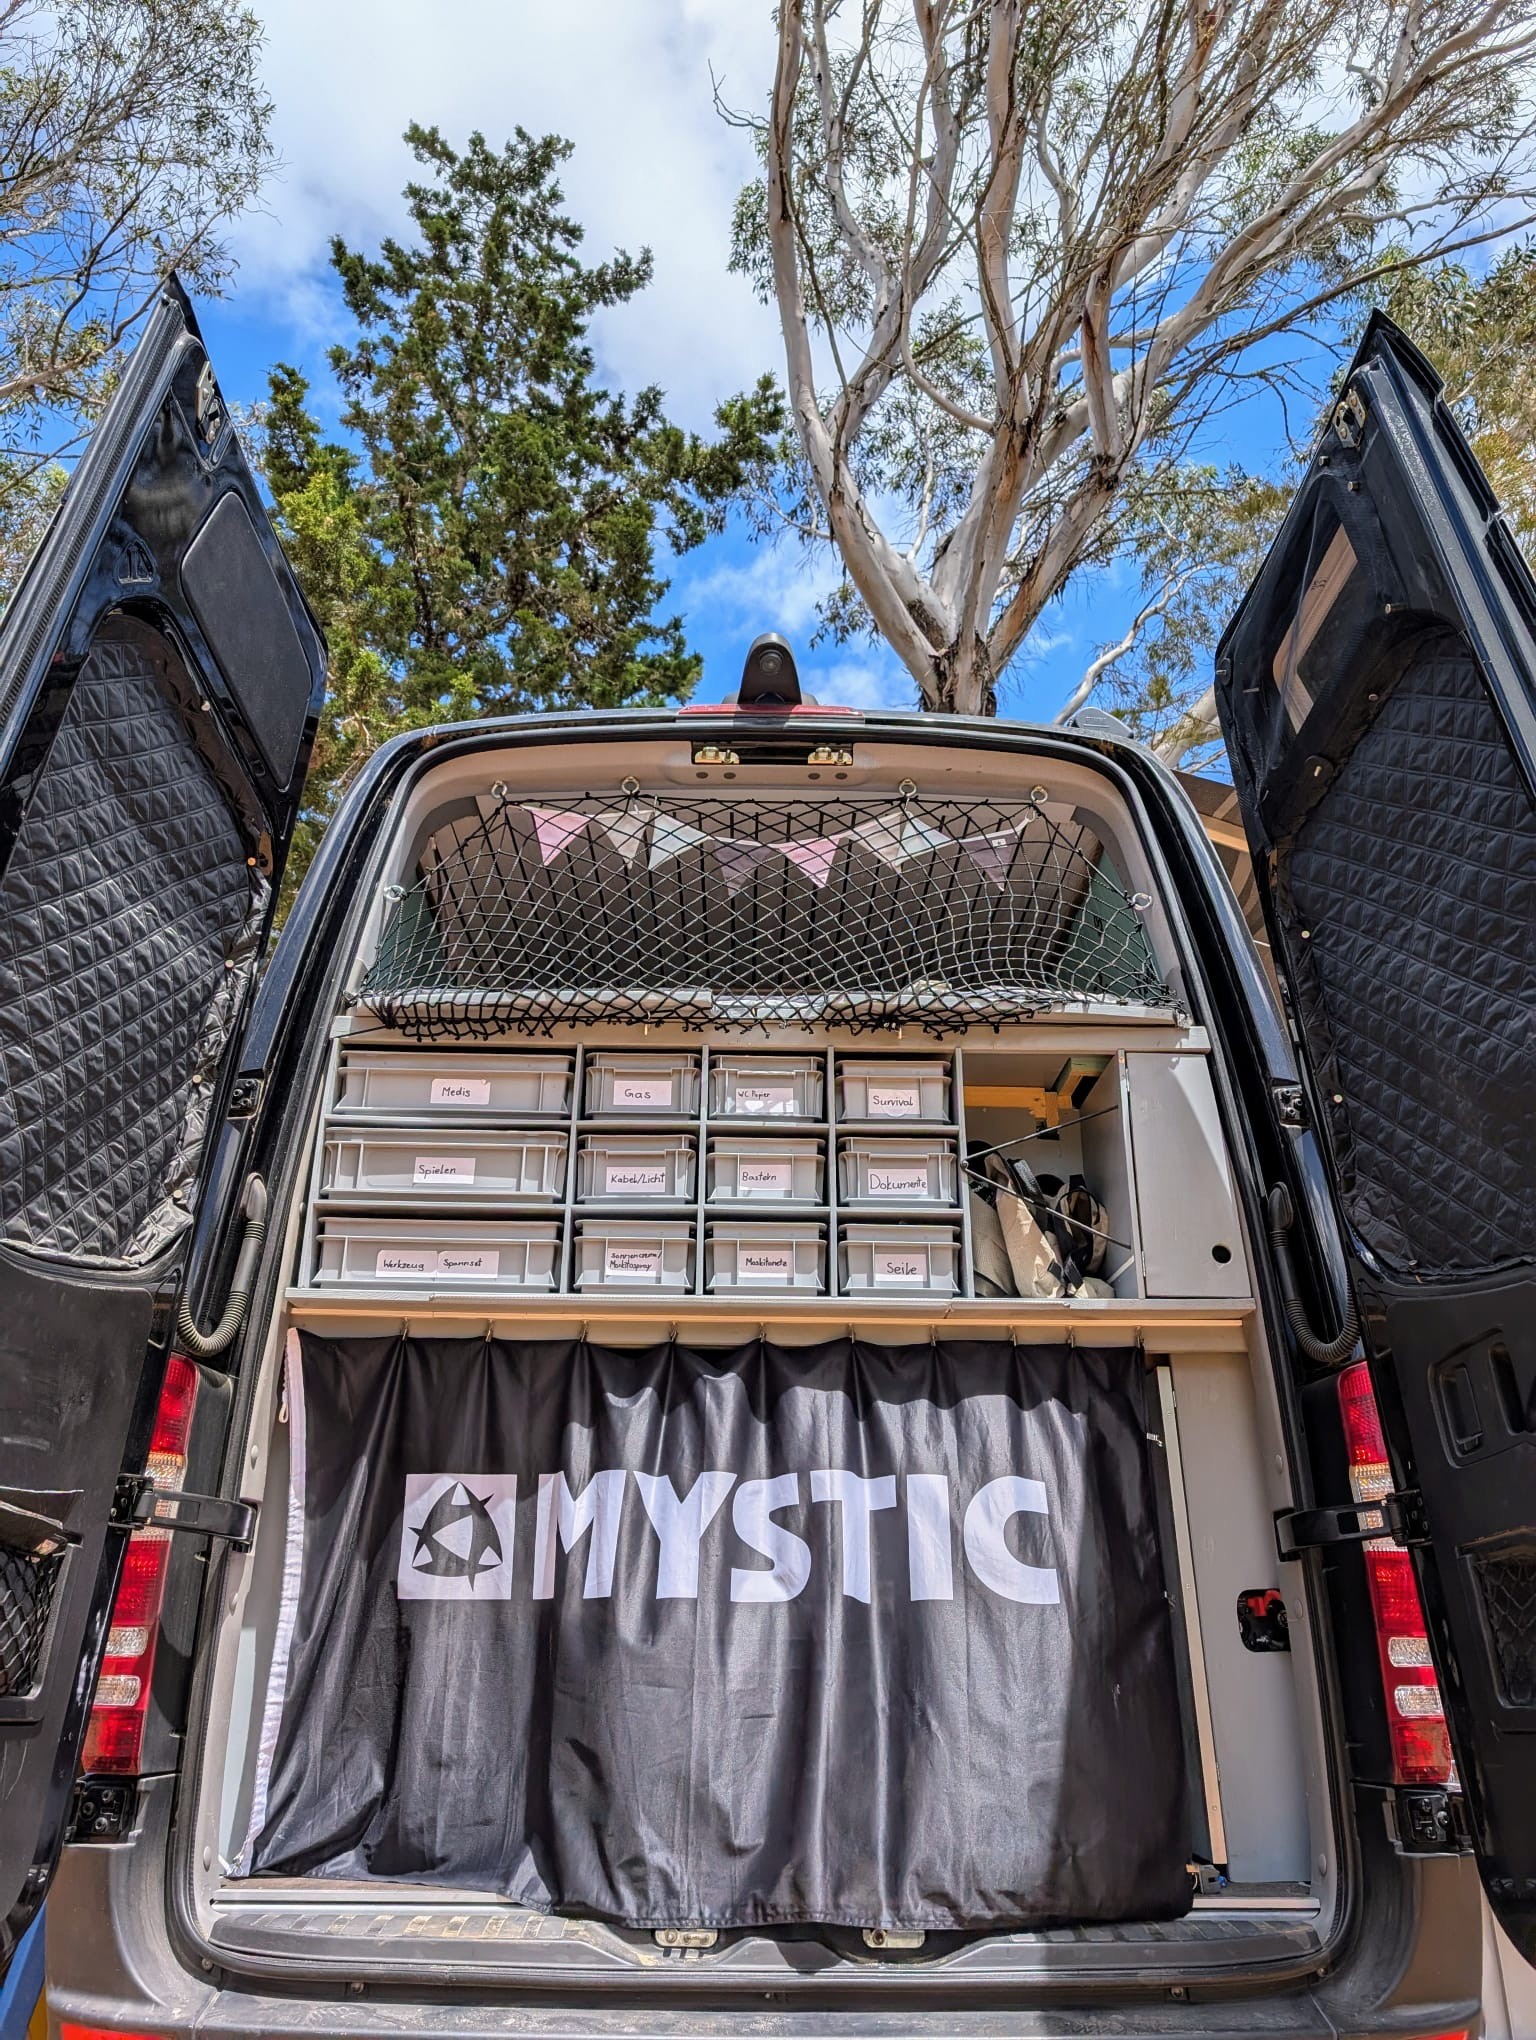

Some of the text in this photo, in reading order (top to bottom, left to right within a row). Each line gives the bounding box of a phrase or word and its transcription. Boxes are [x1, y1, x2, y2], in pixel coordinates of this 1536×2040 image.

[441, 1086, 471, 1098] Medis
[624, 1088, 651, 1099] Gas
[738, 1090, 771, 1101] WC Papier
[872, 1095, 914, 1106] Survival
[418, 1164, 456, 1180] Spielen
[870, 1173, 928, 1190] Dokumente
[383, 1259, 425, 1271] Werkzeug
[886, 1261, 917, 1275] Seile
[533, 1469, 1061, 1604] MYSTIC
